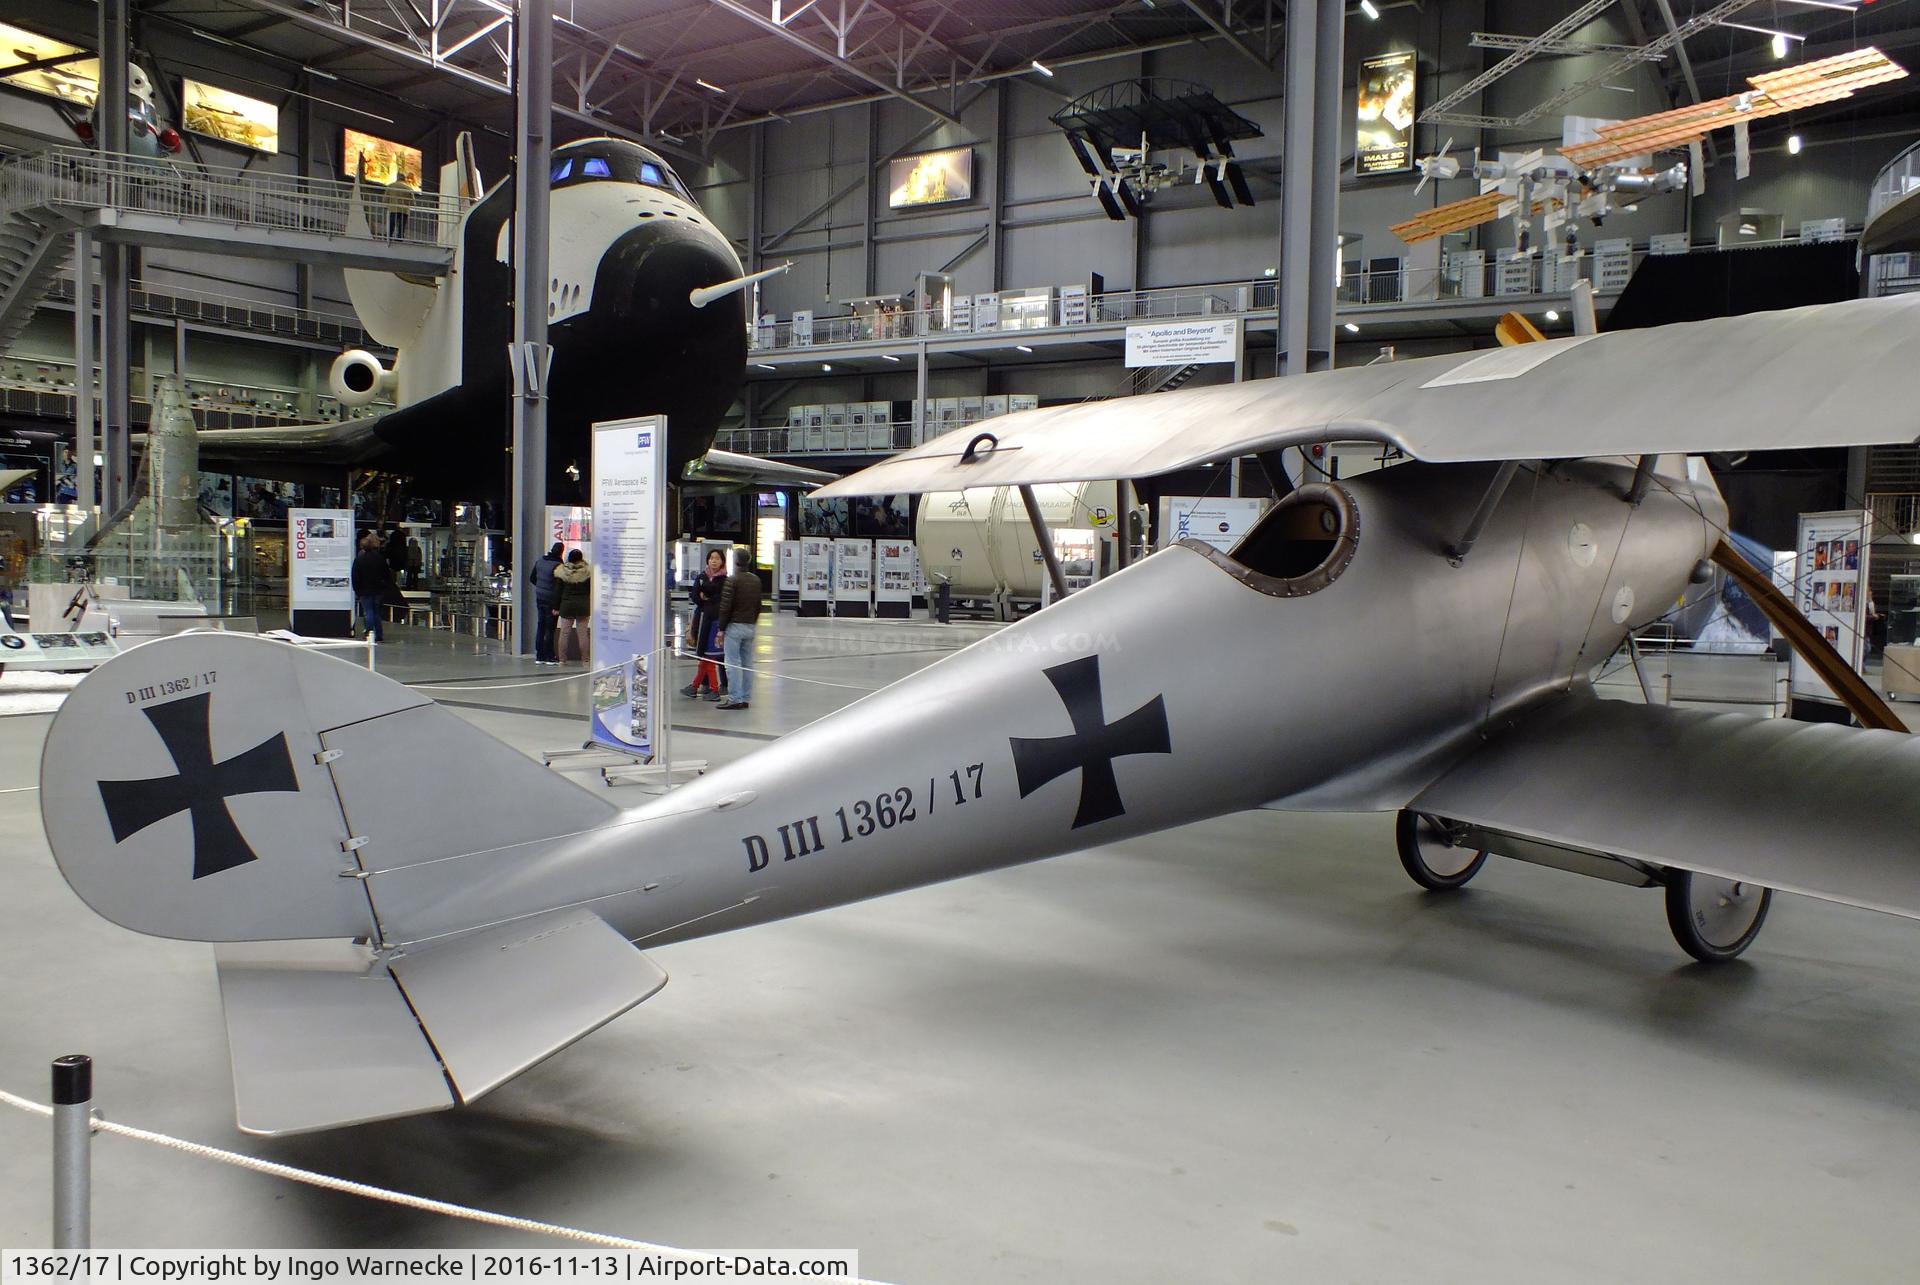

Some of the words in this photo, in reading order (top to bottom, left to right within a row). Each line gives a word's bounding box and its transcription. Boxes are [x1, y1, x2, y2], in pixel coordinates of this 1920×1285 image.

[1364, 154, 1389, 162] IMAX
[1390, 152, 1404, 160] 3D
[638, 436, 651, 446] PFW
[615, 478, 639, 487] Aerospace
[640, 476, 648, 485] AG
[297, 519, 306, 559] BOR-5
[126, 691, 136, 704] D
[138, 686, 156, 701] III
[160, 677, 191, 696] 1362
[203, 671, 217, 685] 17
[742, 836, 769, 873] D
[777, 816, 825, 862] III
[835, 787, 917, 844] 1362
[928, 777, 935, 815] /
[950, 762, 984, 805] 17
